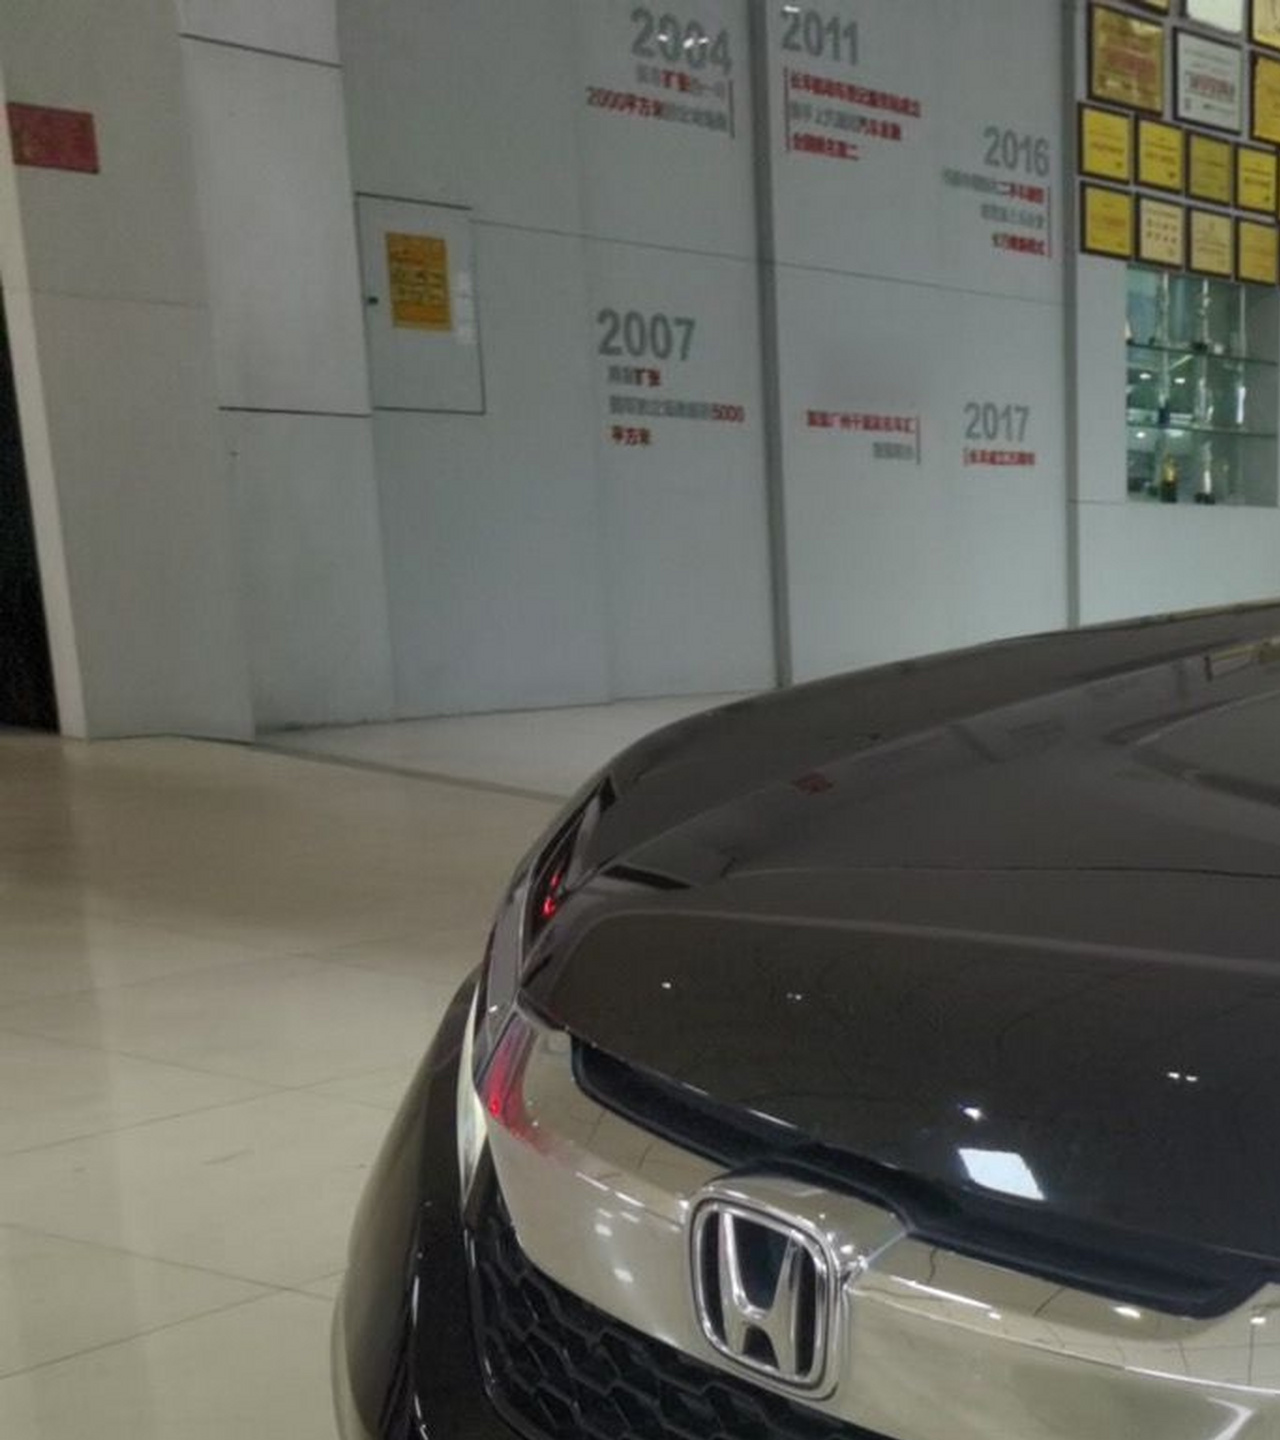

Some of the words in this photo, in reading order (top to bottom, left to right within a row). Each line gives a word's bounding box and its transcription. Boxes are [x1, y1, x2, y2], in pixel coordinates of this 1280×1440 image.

[780, 8, 859, 66] 2011
[982, 126, 1050, 177] 2016
[596, 308, 697, 361] 2007
[963, 401, 1031, 442] 2017
